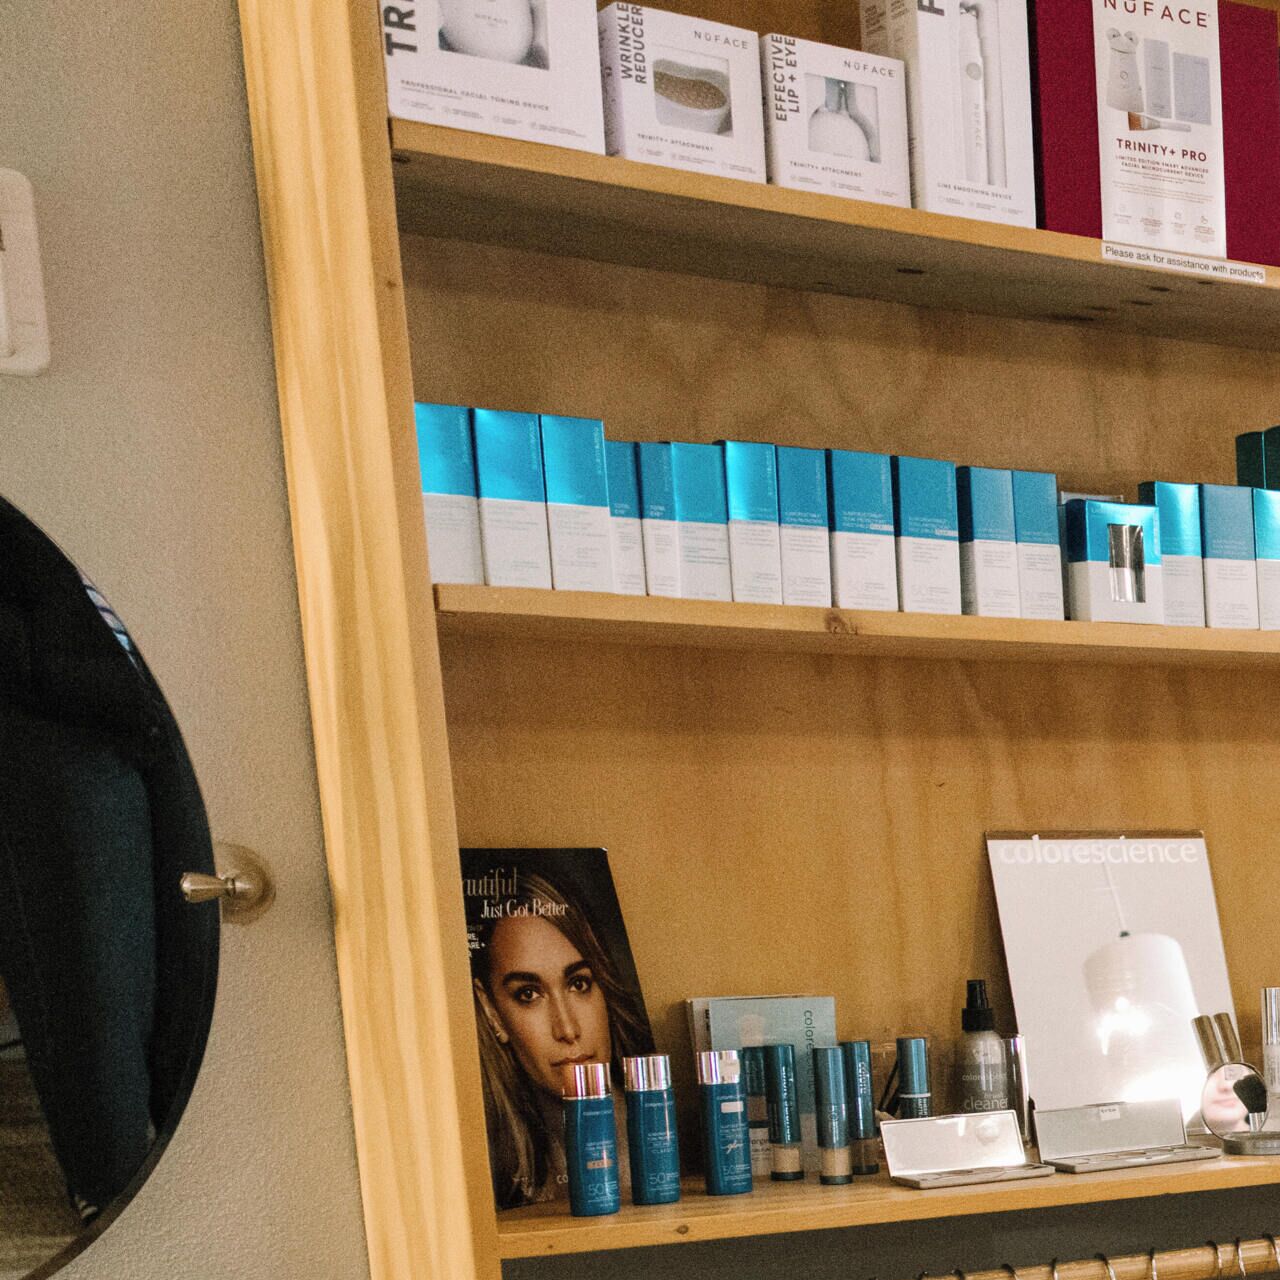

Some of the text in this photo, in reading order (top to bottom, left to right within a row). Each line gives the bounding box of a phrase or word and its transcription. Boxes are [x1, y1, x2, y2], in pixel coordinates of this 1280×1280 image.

[383, 0, 418, 56] TR
[617, 3, 633, 79] WRINKLE
[631, 7, 647, 84] REDUCER
[784, 39, 797, 67] EYE
[771, 35, 787, 122] EFFECTIVE
[788, 90, 800, 114] LIP
[1116, 138, 1207, 162] TRINITY+ PRO
[1105, 245, 1264, 282] Please ask for assistance with products
[1001, 834, 1200, 864] colorescience
[480, 898, 568, 919] Just Got Better
